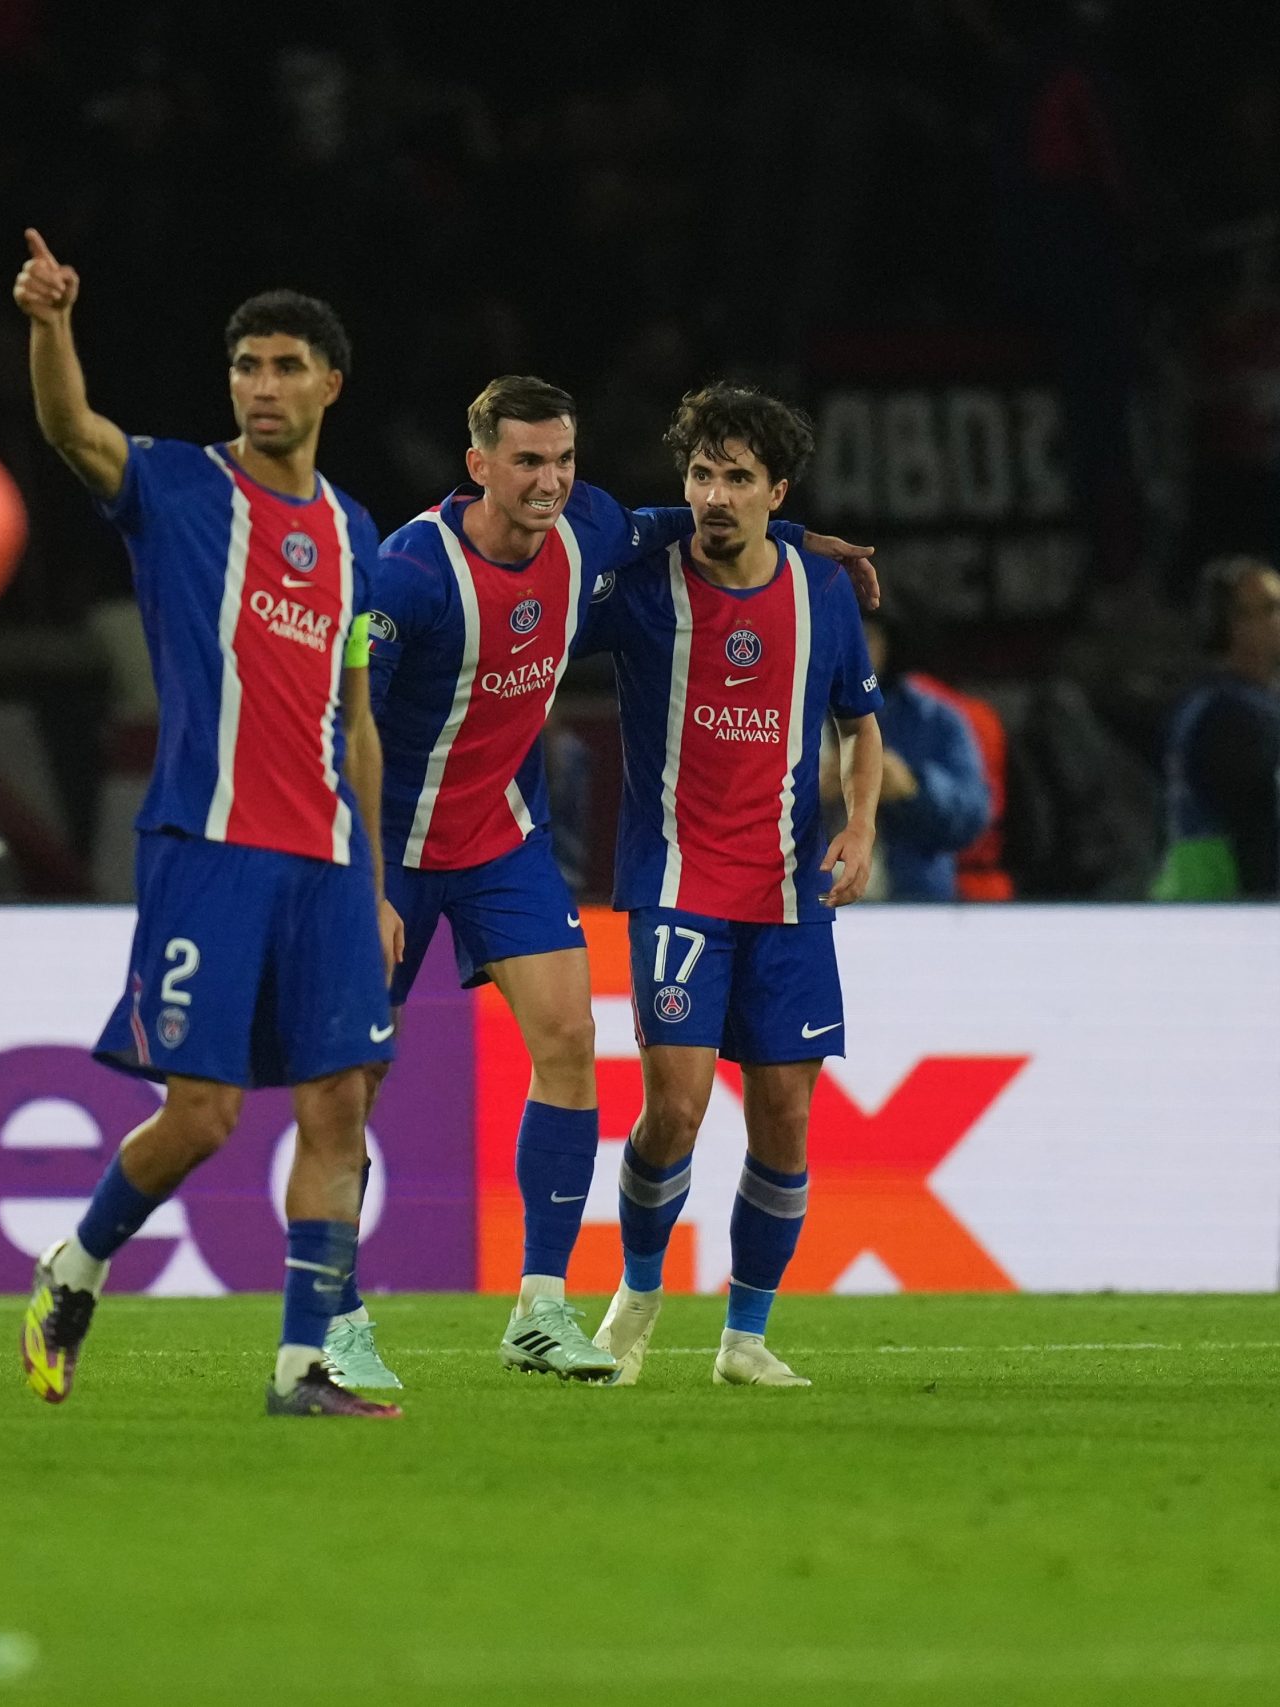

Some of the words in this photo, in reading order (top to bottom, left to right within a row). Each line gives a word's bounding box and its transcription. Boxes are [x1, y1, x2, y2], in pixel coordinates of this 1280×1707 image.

[250, 590, 332, 640] QATAR
[732, 631, 756, 642] PARIS
[481, 656, 554, 694] QATAR
[693, 705, 780, 730] QATAR
[715, 728, 780, 744] AIRWAYS
[654, 925, 706, 983] 17
[161, 937, 200, 1006] 2
[660, 987, 684, 997] PARIS
